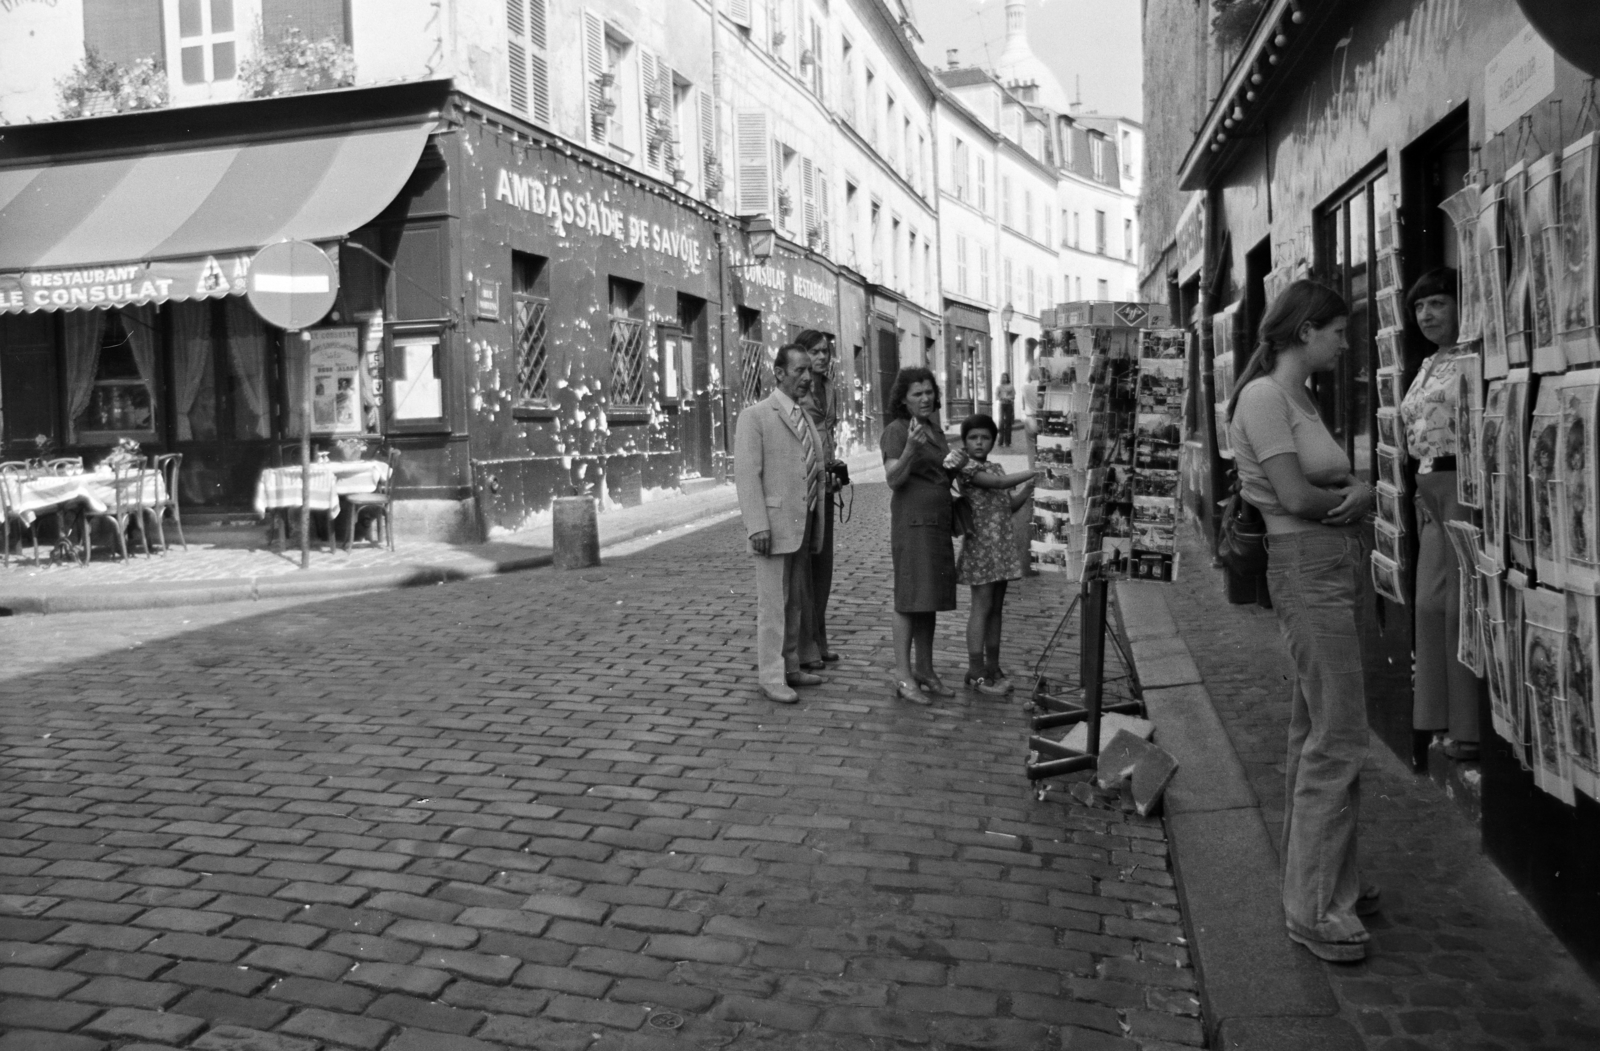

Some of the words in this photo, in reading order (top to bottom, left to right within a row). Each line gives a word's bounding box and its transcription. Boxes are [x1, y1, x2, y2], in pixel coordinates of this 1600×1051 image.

[496, 168, 624, 240] AMBASSADE
[629, 214, 650, 249] DE
[652, 223, 700, 266] SAVOIE
[30, 266, 139, 287] RESTAURANT
[744, 258, 785, 292] CONSULAT
[0, 290, 24, 307] LE
[33, 279, 173, 306] CONSULAT
[1120, 305, 1142, 321] Agfa
